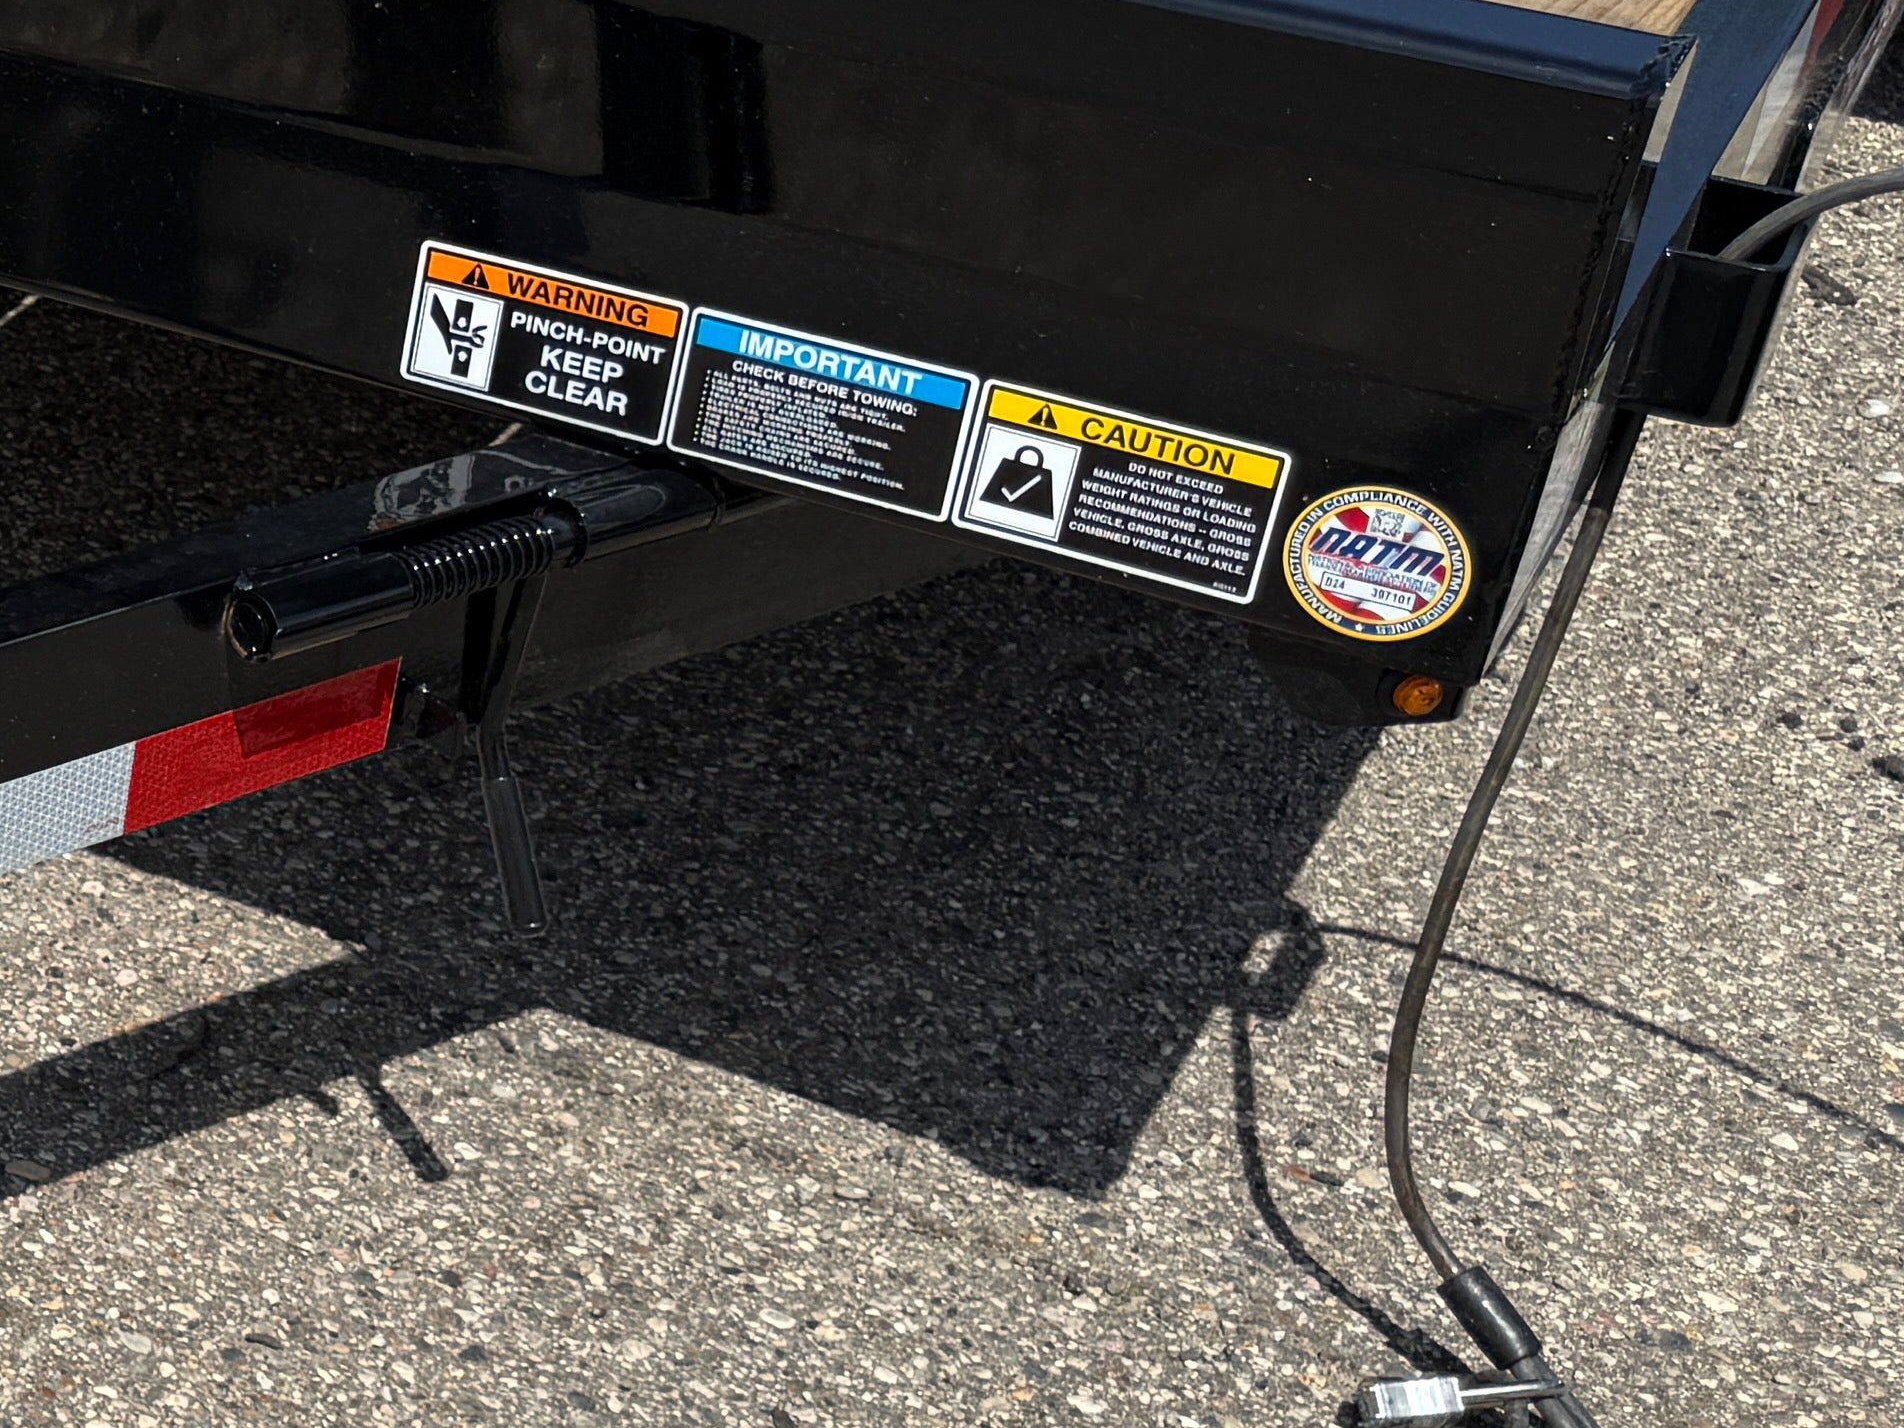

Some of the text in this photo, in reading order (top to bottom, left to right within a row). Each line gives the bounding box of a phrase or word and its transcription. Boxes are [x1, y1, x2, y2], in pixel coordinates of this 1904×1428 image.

[505, 273, 650, 327] WARNING
[509, 310, 666, 366] PINCH-POINT
[738, 328, 923, 396] IMPORTANT
[539, 344, 625, 387] KEEP
[731, 359, 919, 417] CHECK BEFORE TOWING:
[523, 368, 630, 416] CLEAR
[1078, 415, 1236, 475] CAUTION
[1127, 462, 1224, 495] DO NOT EXCEED
[1323, 491, 1426, 515] COMPLIANCE
[1077, 493, 1197, 533] RECOMMENDATIONS
[1208, 526, 1253, 547] GROSS
[1079, 478, 1257, 533] WEIGHT RATINGS OR LOADING
[1200, 494, 1253, 516] VEHICLE
[1307, 507, 1322, 523] IN
[1427, 511, 1459, 547] WITH
[1067, 520, 1248, 575] COMBINED VEHICLE AND AXLE.
[1125, 520, 1170, 541] GROSS
[1170, 532, 1206, 551] AXLE,
[1206, 540, 1251, 561] GROSS
[1310, 527, 1445, 577] NATM
[1290, 521, 1343, 623] MANUFACTURED
[1450, 549, 1464, 589] NATM
